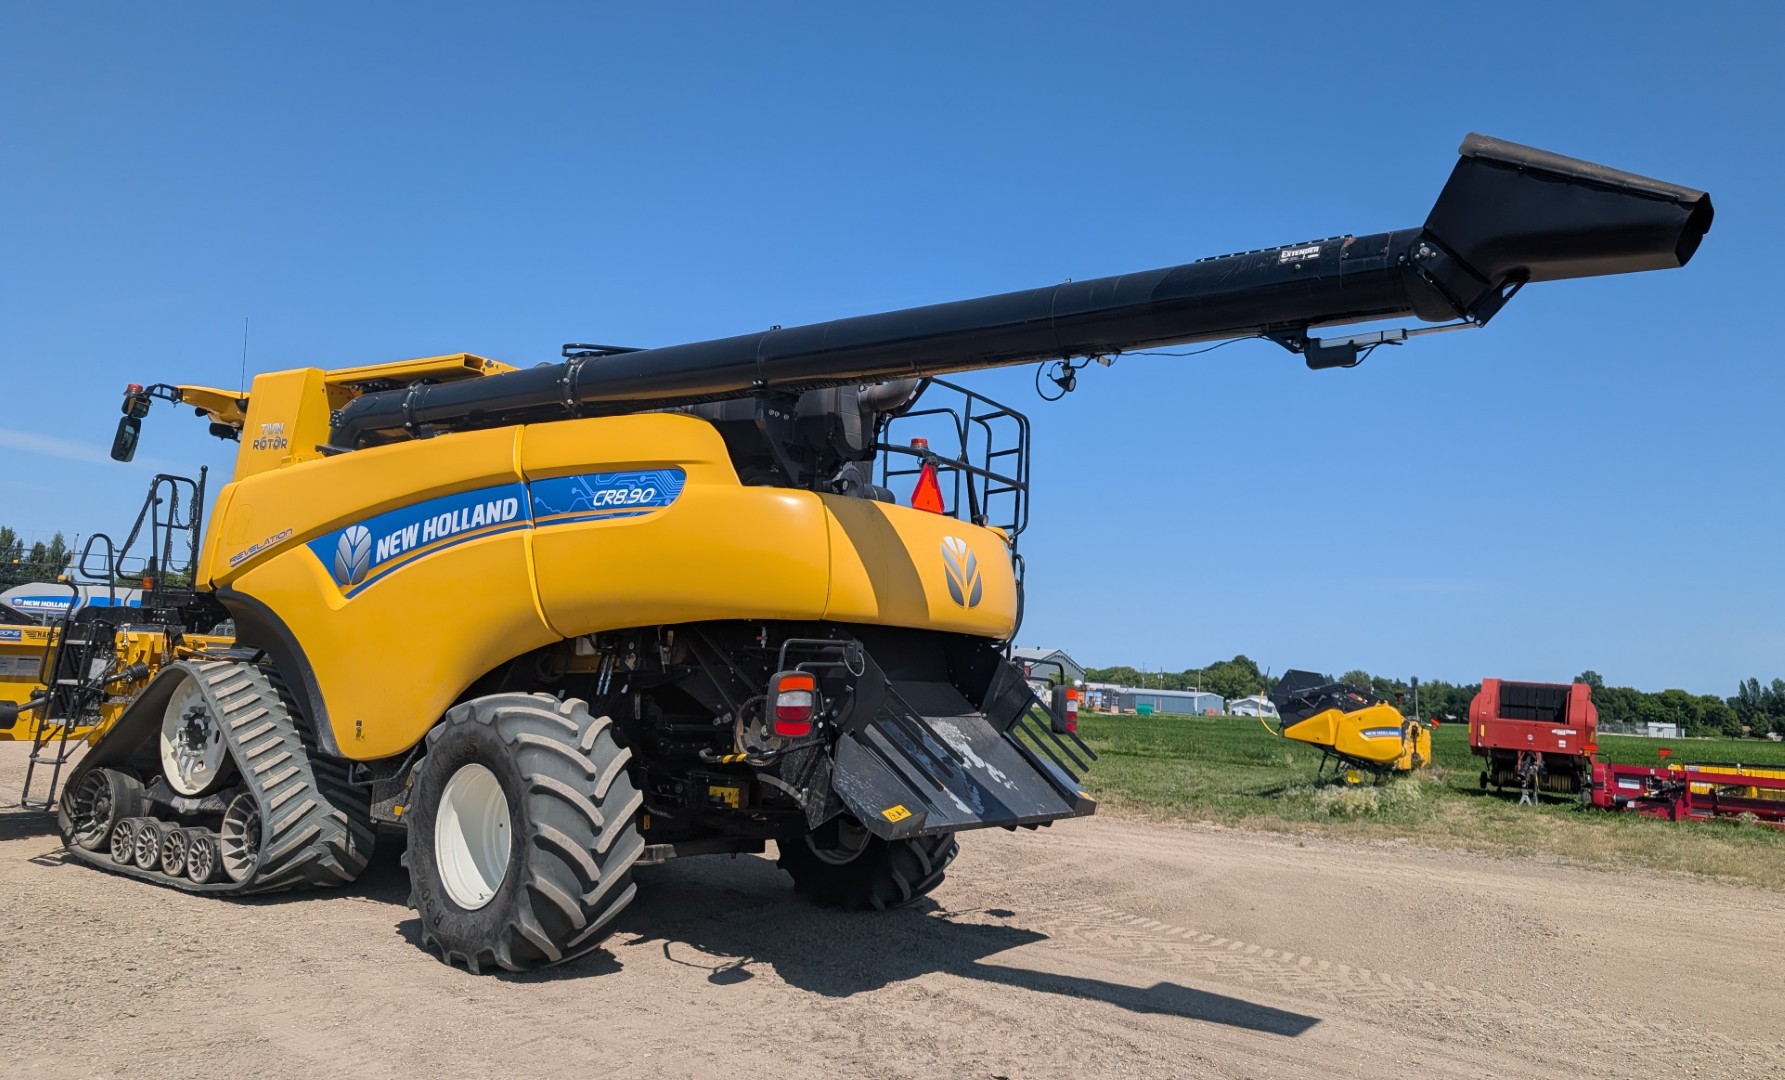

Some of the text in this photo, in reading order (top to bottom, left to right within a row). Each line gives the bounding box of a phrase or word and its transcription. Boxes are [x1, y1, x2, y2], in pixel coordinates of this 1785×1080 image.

[261, 422, 285, 435] TWIN
[252, 436, 288, 451] ROTOR
[592, 487, 656, 507] CR8.90
[375, 497, 518, 564] NEW HOLLAND
[229, 528, 293, 564] REVELATION
